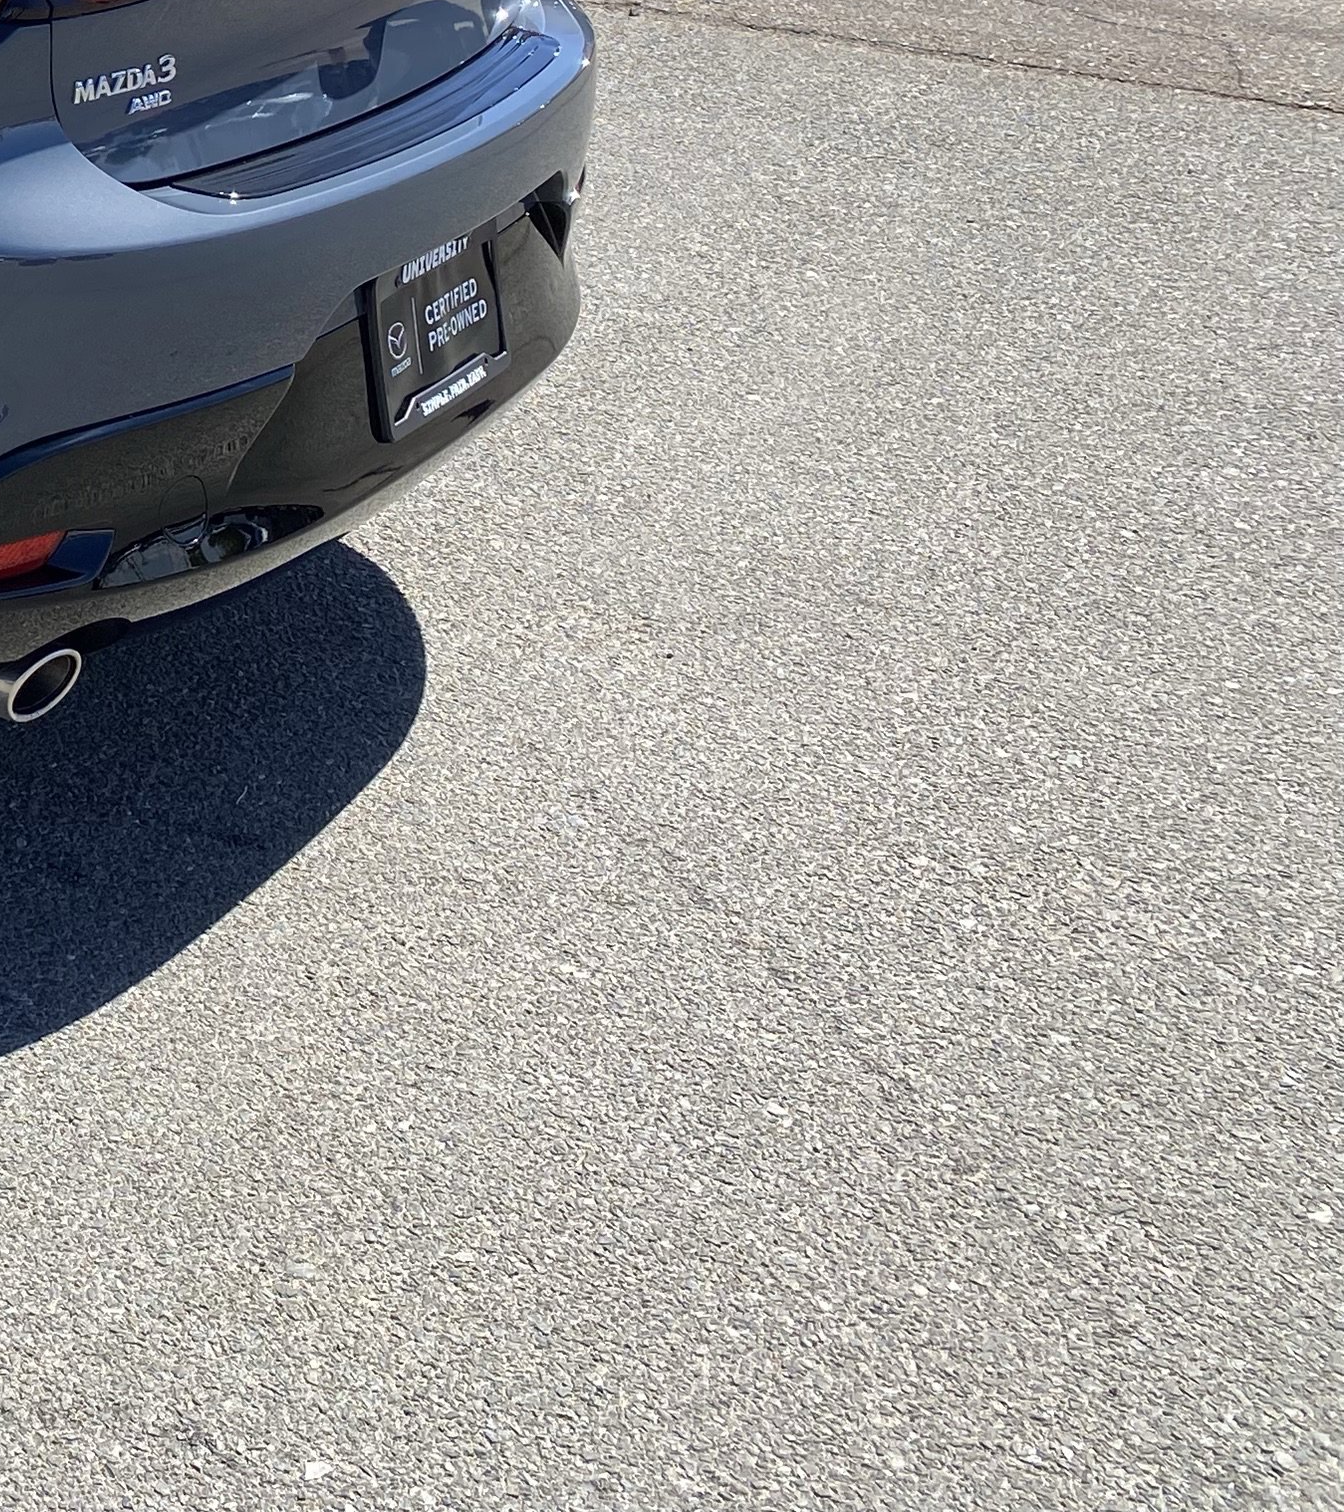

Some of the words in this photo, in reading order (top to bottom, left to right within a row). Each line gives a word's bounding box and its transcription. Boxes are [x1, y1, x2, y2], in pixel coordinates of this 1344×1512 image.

[127, 90, 172, 115] AWD
[402, 236, 470, 284] UNIVERSITY
[425, 278, 478, 325] CERTIFIED
[428, 299, 487, 352] PRE-OWNED
